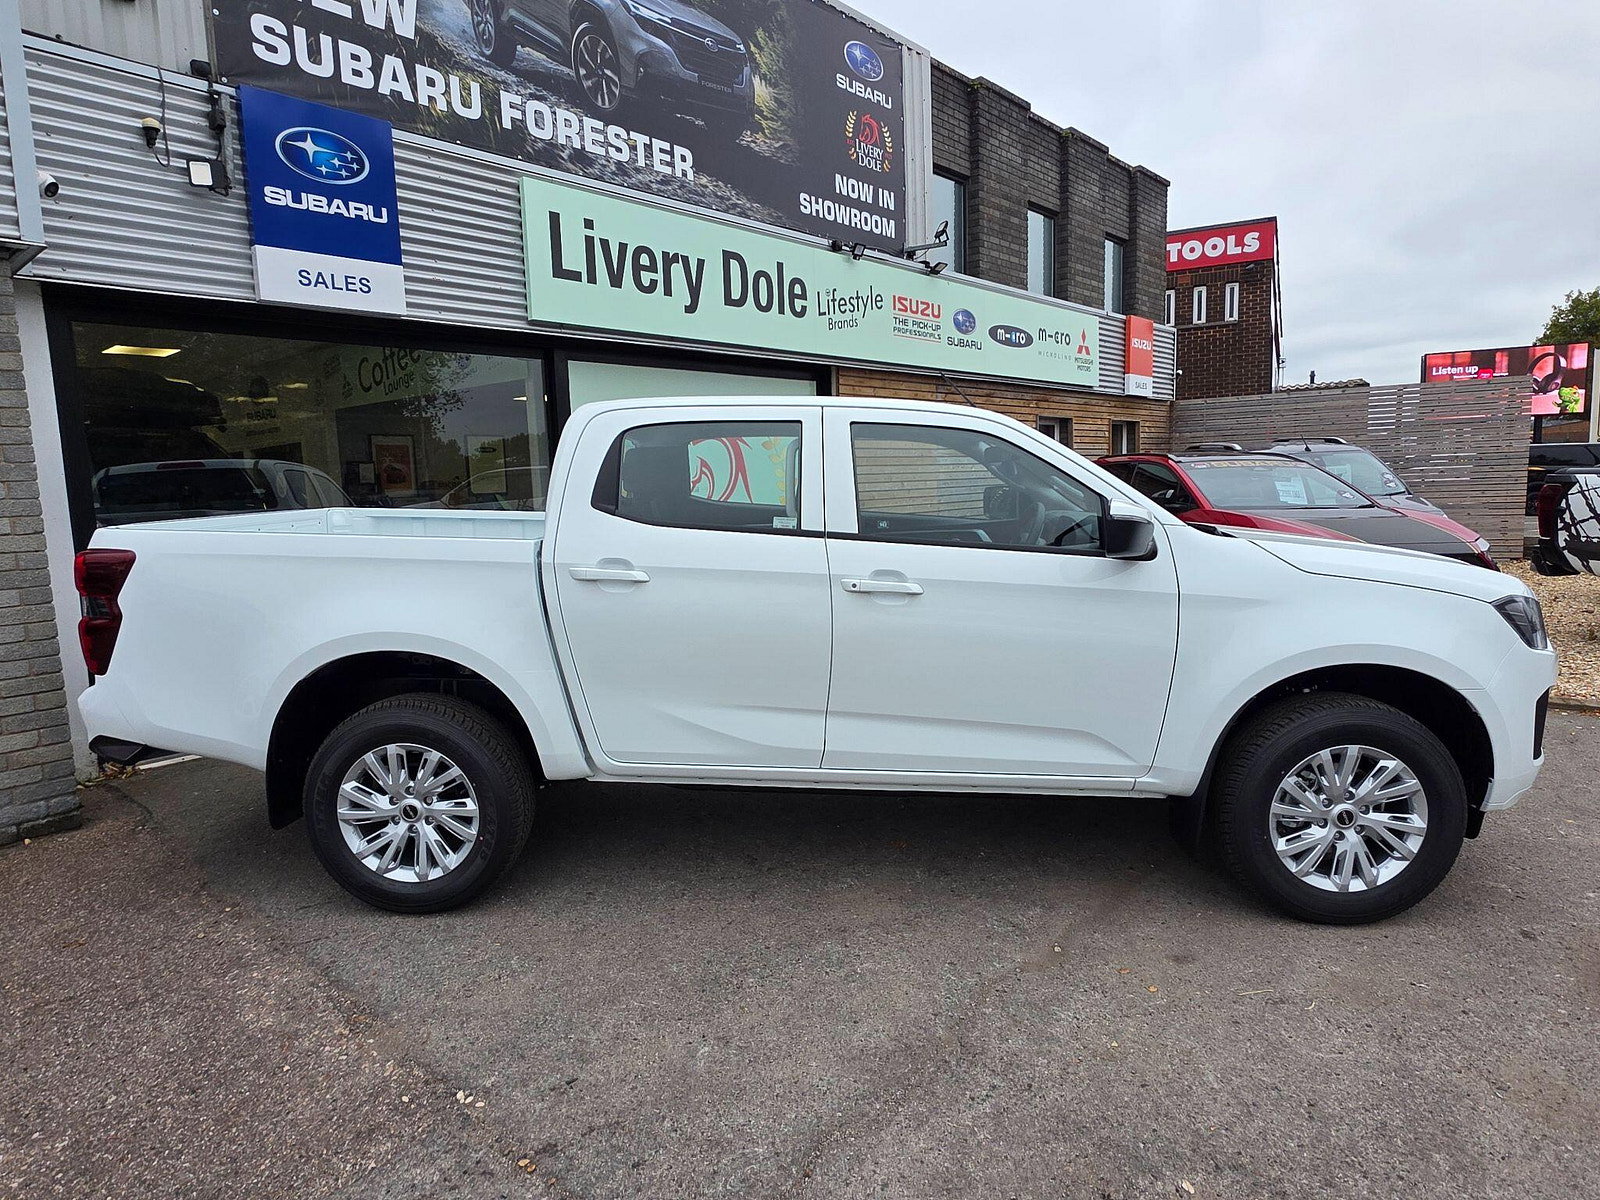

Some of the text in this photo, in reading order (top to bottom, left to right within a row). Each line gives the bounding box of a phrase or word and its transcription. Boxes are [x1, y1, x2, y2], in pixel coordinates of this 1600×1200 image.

[250, 13, 482, 121] SUBARU
[500, 90, 694, 181] FORESTER
[836, 73, 892, 109] SUBARU
[856, 139, 883, 160] LIVERY
[858, 152, 882, 172] DOLE
[264, 186, 388, 224] SUBARU
[835, 174, 895, 211] NOW IN
[799, 192, 896, 239] SHOWROOM
[1166, 231, 1260, 263] TOOLS
[548, 210, 808, 319] Livery Dole
[298, 269, 372, 294] SALES
[817, 285, 883, 318] Lifestyle
[892, 295, 941, 319] ISUZU
[828, 314, 858, 331] Brands
[893, 316, 942, 332] THE PICK-UP
[946, 336, 982, 351] SUBARU
[1131, 338, 1152, 351] ISUZU
[358, 346, 421, 392] Coffee
[1432, 365, 1479, 376] Listen up
[383, 370, 415, 396] Lounge
